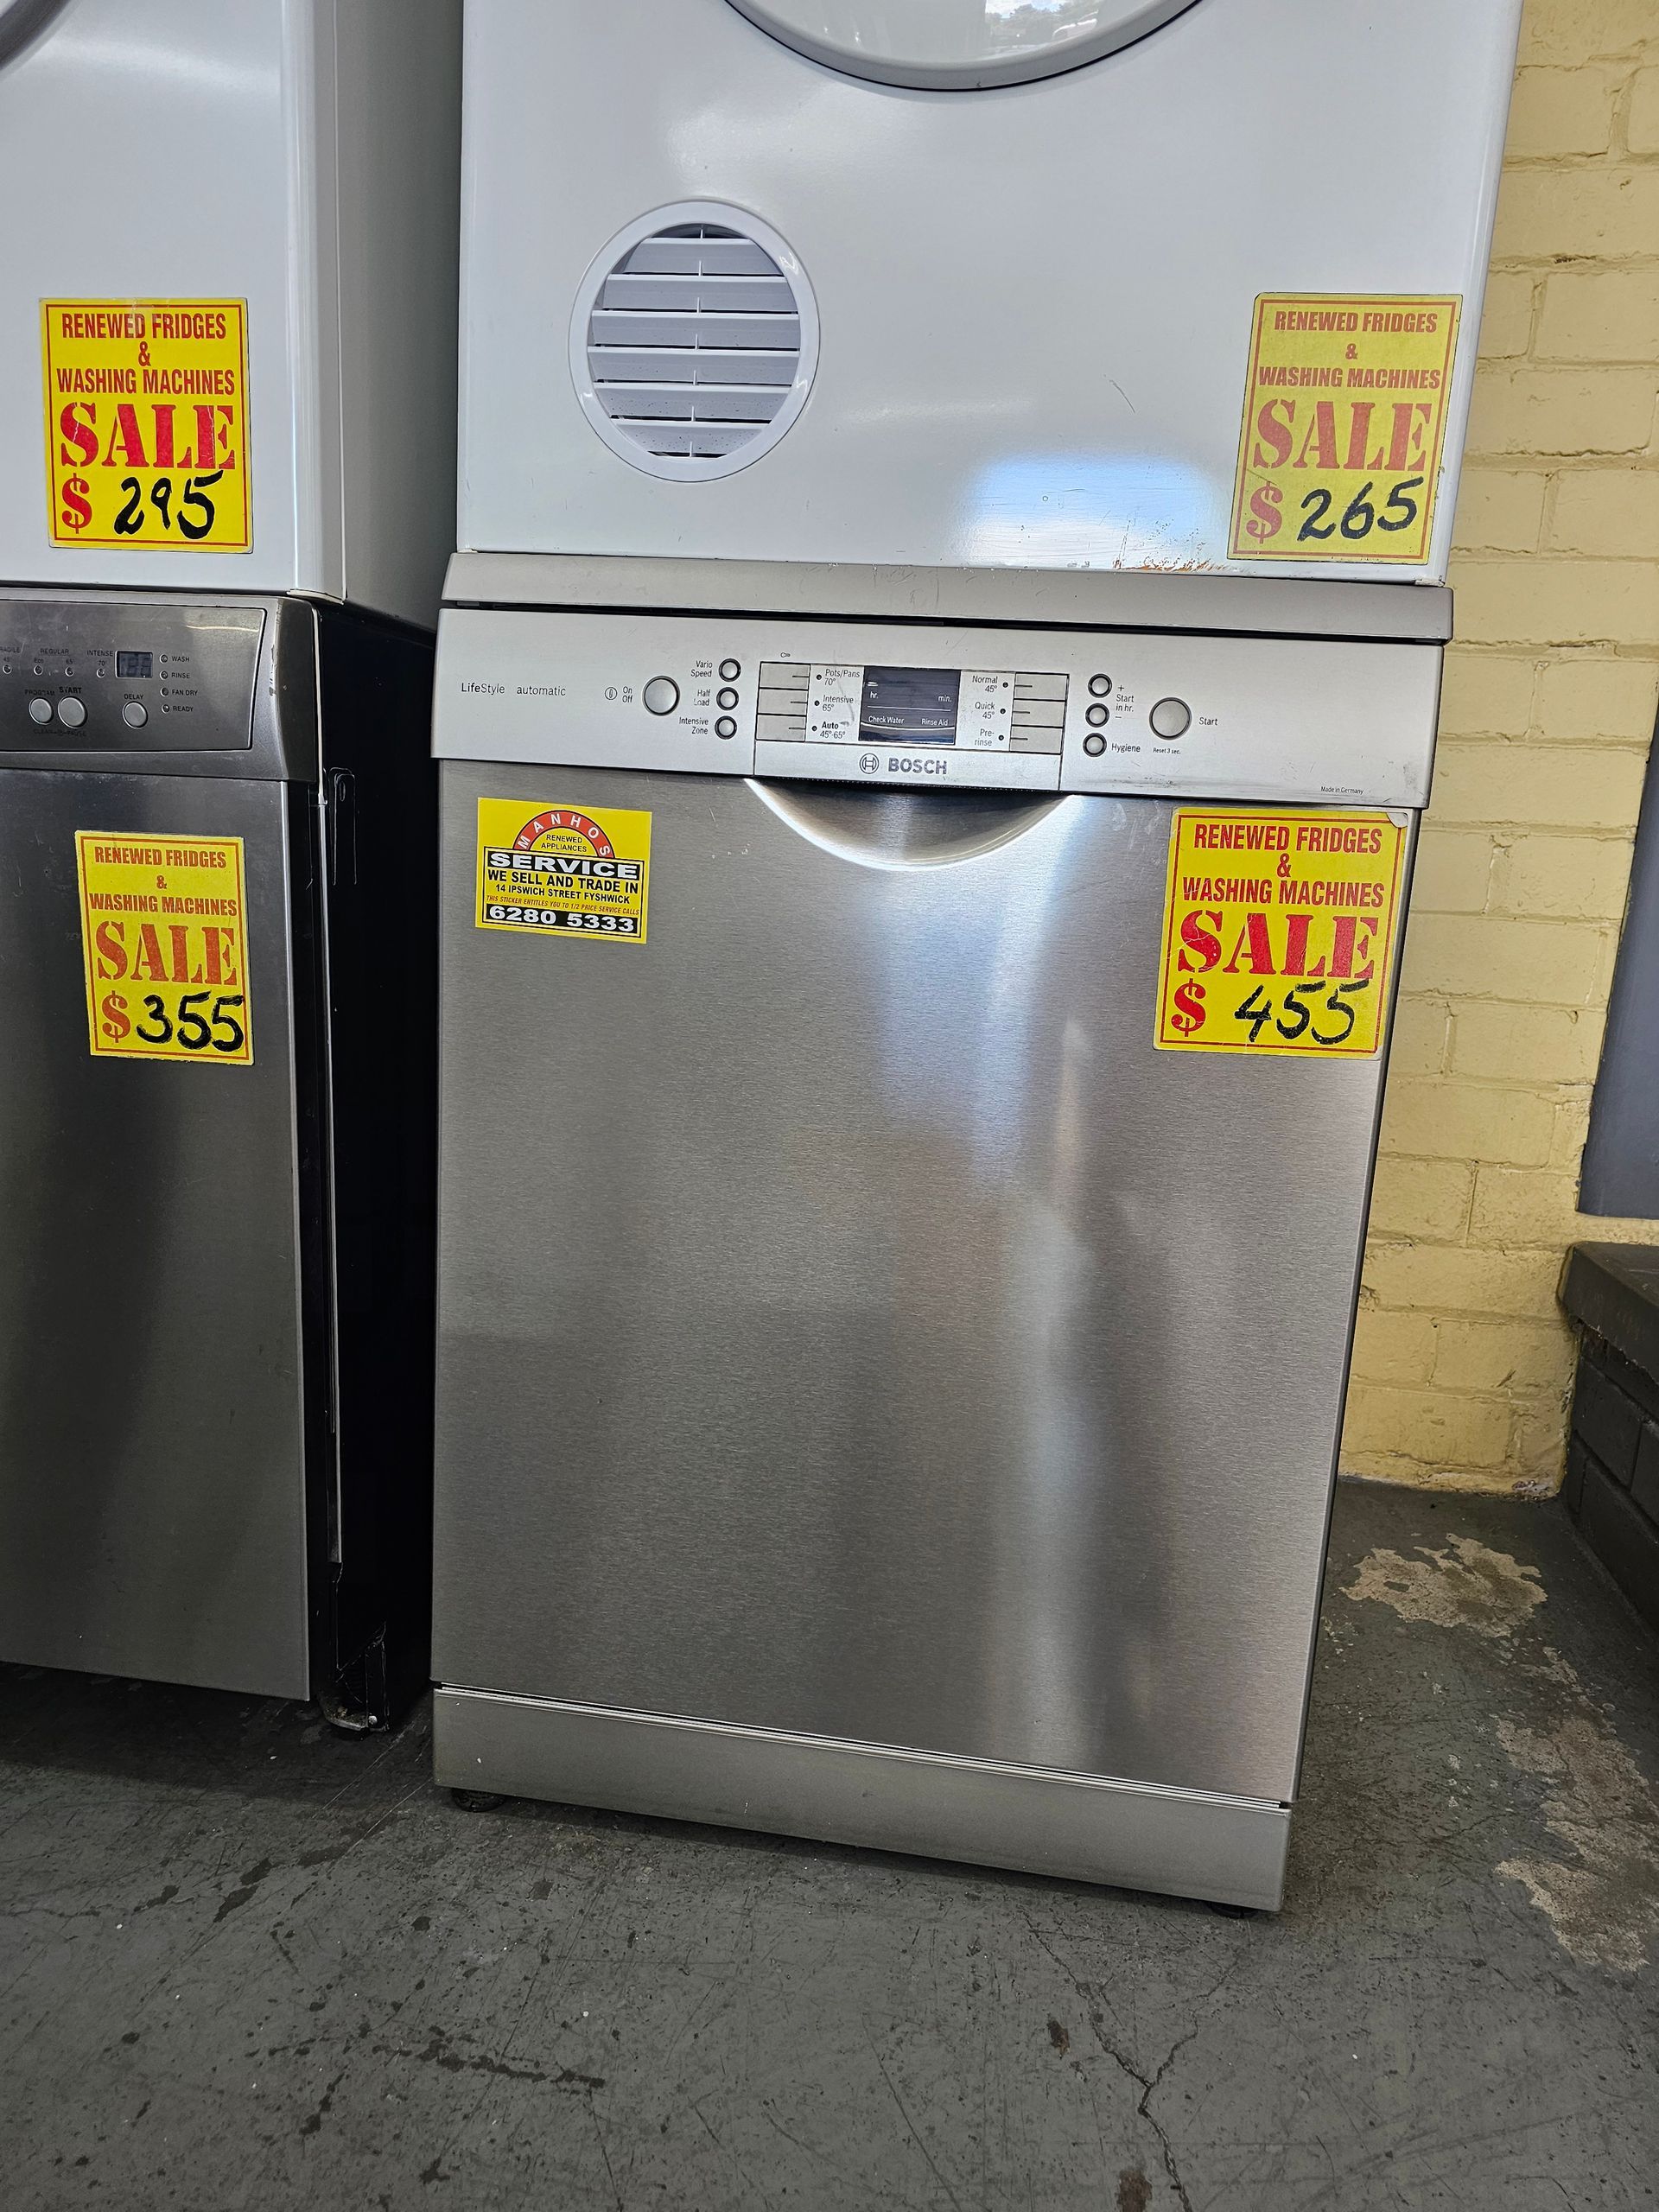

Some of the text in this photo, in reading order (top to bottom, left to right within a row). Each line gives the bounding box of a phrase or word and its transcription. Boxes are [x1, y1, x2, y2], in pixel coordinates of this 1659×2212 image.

[62, 313, 226, 339] RENEWED FRIDGES
[1274, 311, 1438, 333] RENEWED FRIDGES
[138, 340, 151, 366] &
[1345, 343, 1358, 360] &
[57, 368, 235, 395] WASHING MACHINES
[1259, 366, 1441, 389] WASHING MACHINES
[60, 402, 235, 470] SALE
[1253, 399, 1432, 472] SALE
[62, 470, 224, 539] $ 295
[1246, 476, 1424, 543] $ 265
[691, 669, 712, 677] Speed
[825, 669, 860, 678] Pots/Pans
[972, 675, 998, 683] Normal
[461, 683, 505, 696] LifeStyle
[517, 685, 566, 696] automatic
[622, 695, 633, 703] Off
[823, 695, 854, 703] Intensive
[1116, 694, 1134, 702] Start
[679, 716, 709, 725] Intensive
[1198, 717, 1218, 726] Start
[975, 738, 992, 747] rinse
[1111, 743, 1141, 753] Hygiene
[887, 757, 947, 774] BOSCH
[518, 812, 610, 856] MANHOS
[546, 834, 582, 843] RENEWED
[1194, 823, 1382, 854] RENEWED FRIDGES
[94, 847, 226, 868] RENEWED FRIDGES
[541, 842, 588, 852] APPLIANCES
[490, 853, 638, 880] SERVICE
[1276, 853, 1291, 878] &
[156, 874, 168, 889] &
[487, 869, 639, 894] WE SELL AND TRADE IN
[1183, 876, 1384, 907] WASHING MACHINES
[89, 893, 238, 917] WASHING MACHINES
[500, 896, 522, 905] STICKER
[599, 906, 621, 914] SERVICE
[508, 885, 544, 896] IPSWICH
[548, 889, 581, 899] STREET
[584, 892, 630, 904] FYSHWICK
[489, 906, 634, 932] 6280 5333
[95, 921, 238, 985] SALE
[1177, 910, 1379, 979] SALE
[102, 990, 245, 1052] $ 355
[1171, 978, 1370, 1046] $ 455
